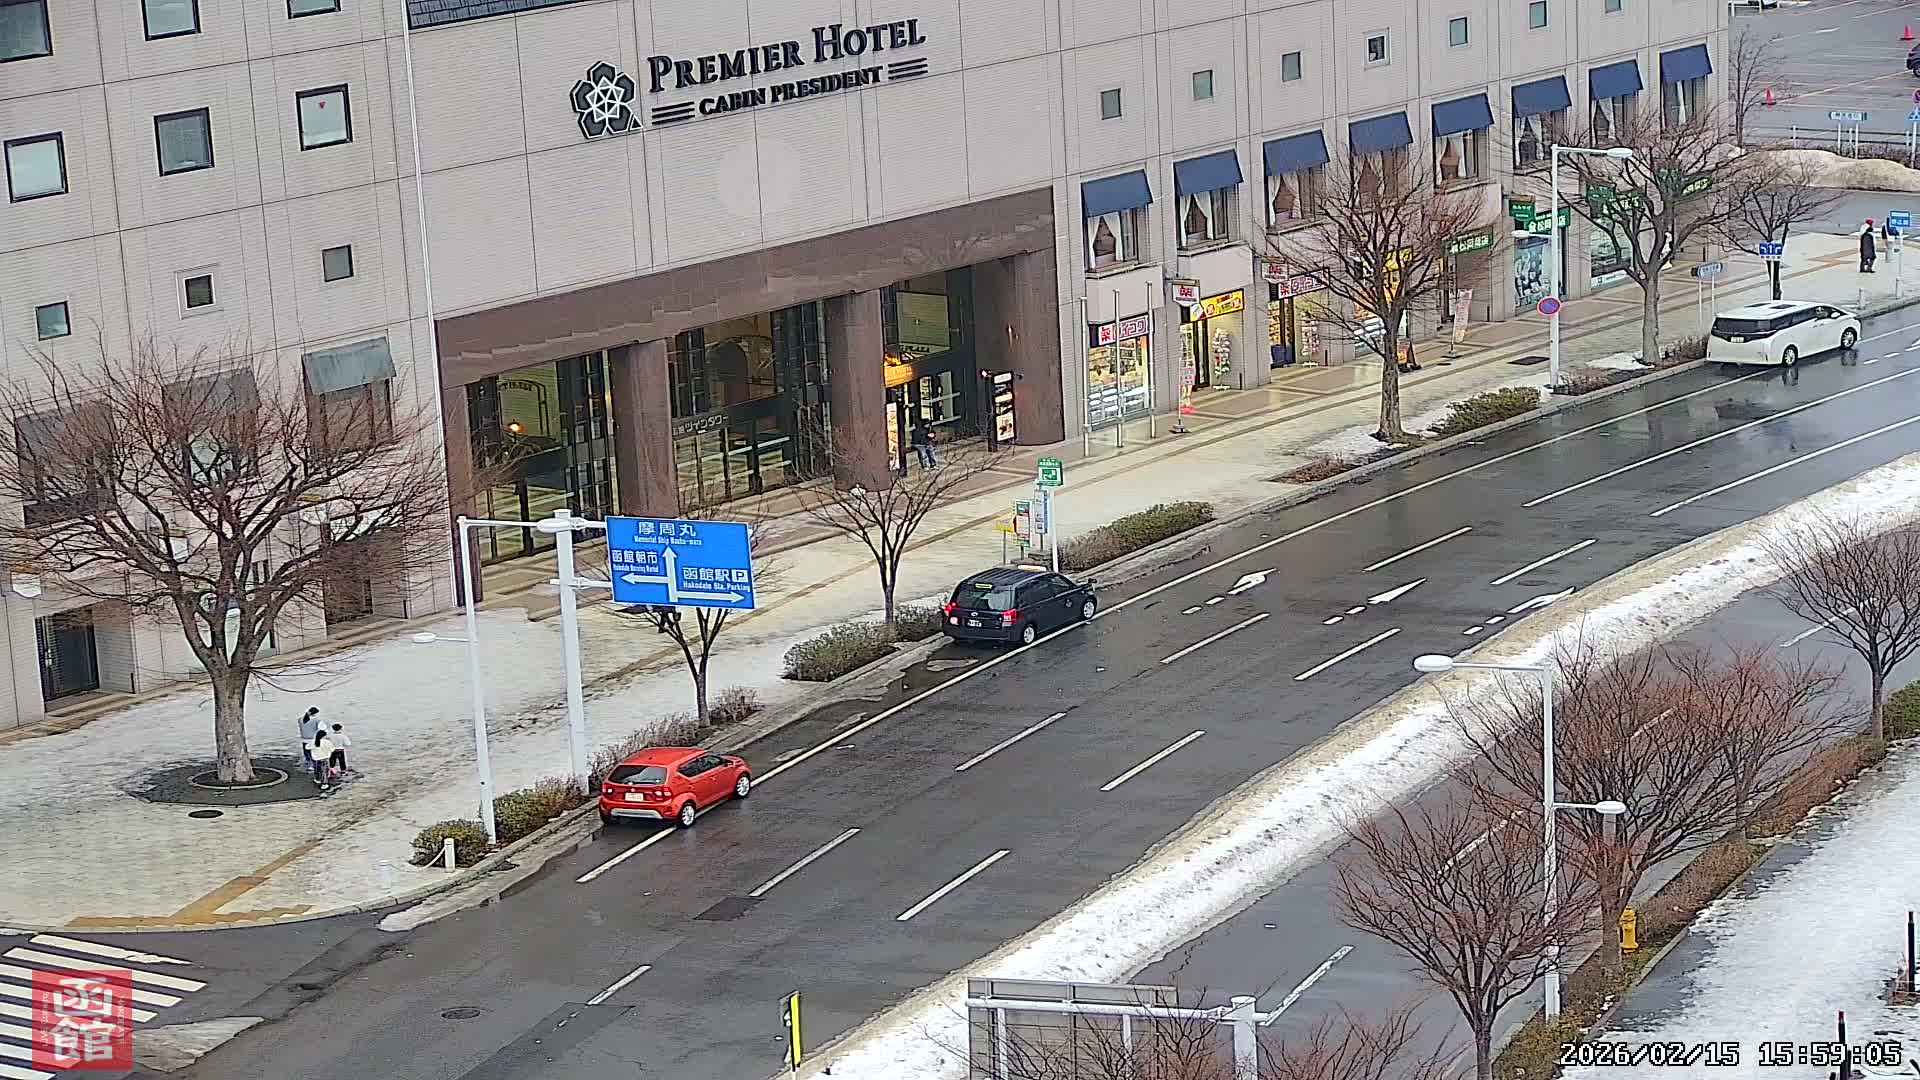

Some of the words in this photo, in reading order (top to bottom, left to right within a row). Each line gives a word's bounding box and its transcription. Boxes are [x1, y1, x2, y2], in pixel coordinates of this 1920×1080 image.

[647, 40, 805, 93] PREMIER
[811, 19, 927, 63] HOTEL
[699, 86, 766, 116] CABIN
[770, 66, 884, 102] PRESIDENT
[639, 522, 696, 536] 摩周丸
[611, 550, 657, 564] 函館朝市
